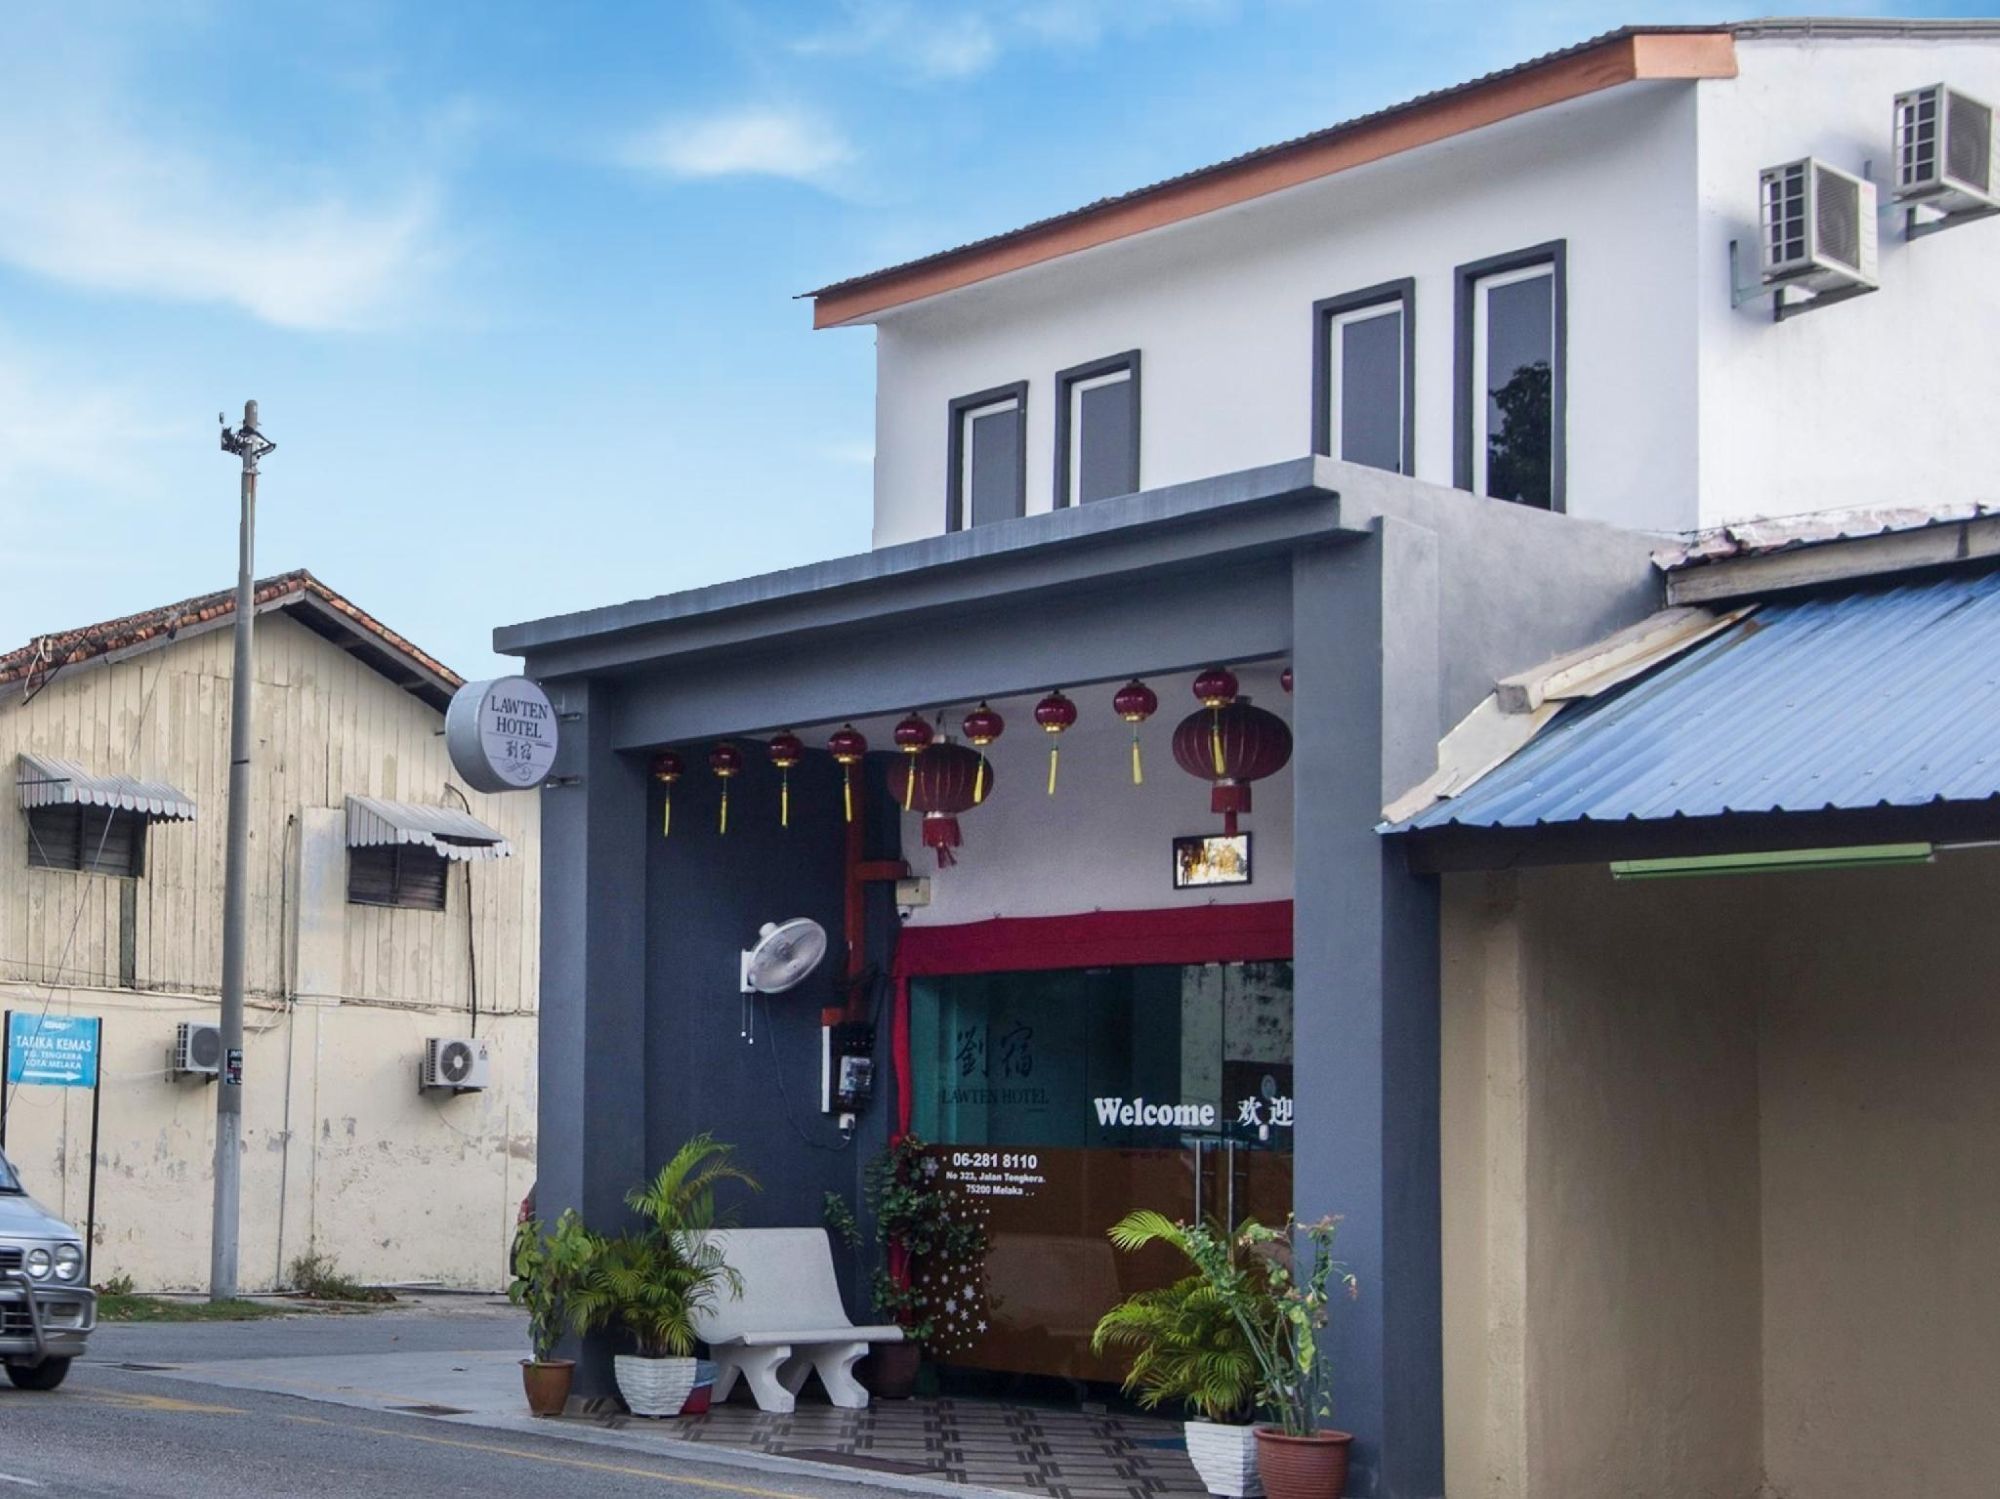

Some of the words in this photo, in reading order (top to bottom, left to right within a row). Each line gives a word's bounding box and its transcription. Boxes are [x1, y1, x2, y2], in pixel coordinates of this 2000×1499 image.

[491, 695, 548, 720] LAWTEN
[496, 716, 542, 739] HOTEL
[56, 1038, 92, 1053] KEMAS
[48, 1060, 82, 1070] MELAKA
[941, 1088, 999, 1105] LAWTEN
[1002, 1088, 1049, 1105] HOTEL
[1094, 1097, 1216, 1127] Welcome
[1237, 1096, 1295, 1126] 欢迎
[952, 1152, 998, 1168] 06-281
[1002, 1153, 1038, 1170] 8110
[945, 1171, 958, 1180] No
[979, 1172, 1003, 1181] Jalan
[965, 1184, 991, 1195] 75200
[992, 1185, 1024, 1195] Melaka
